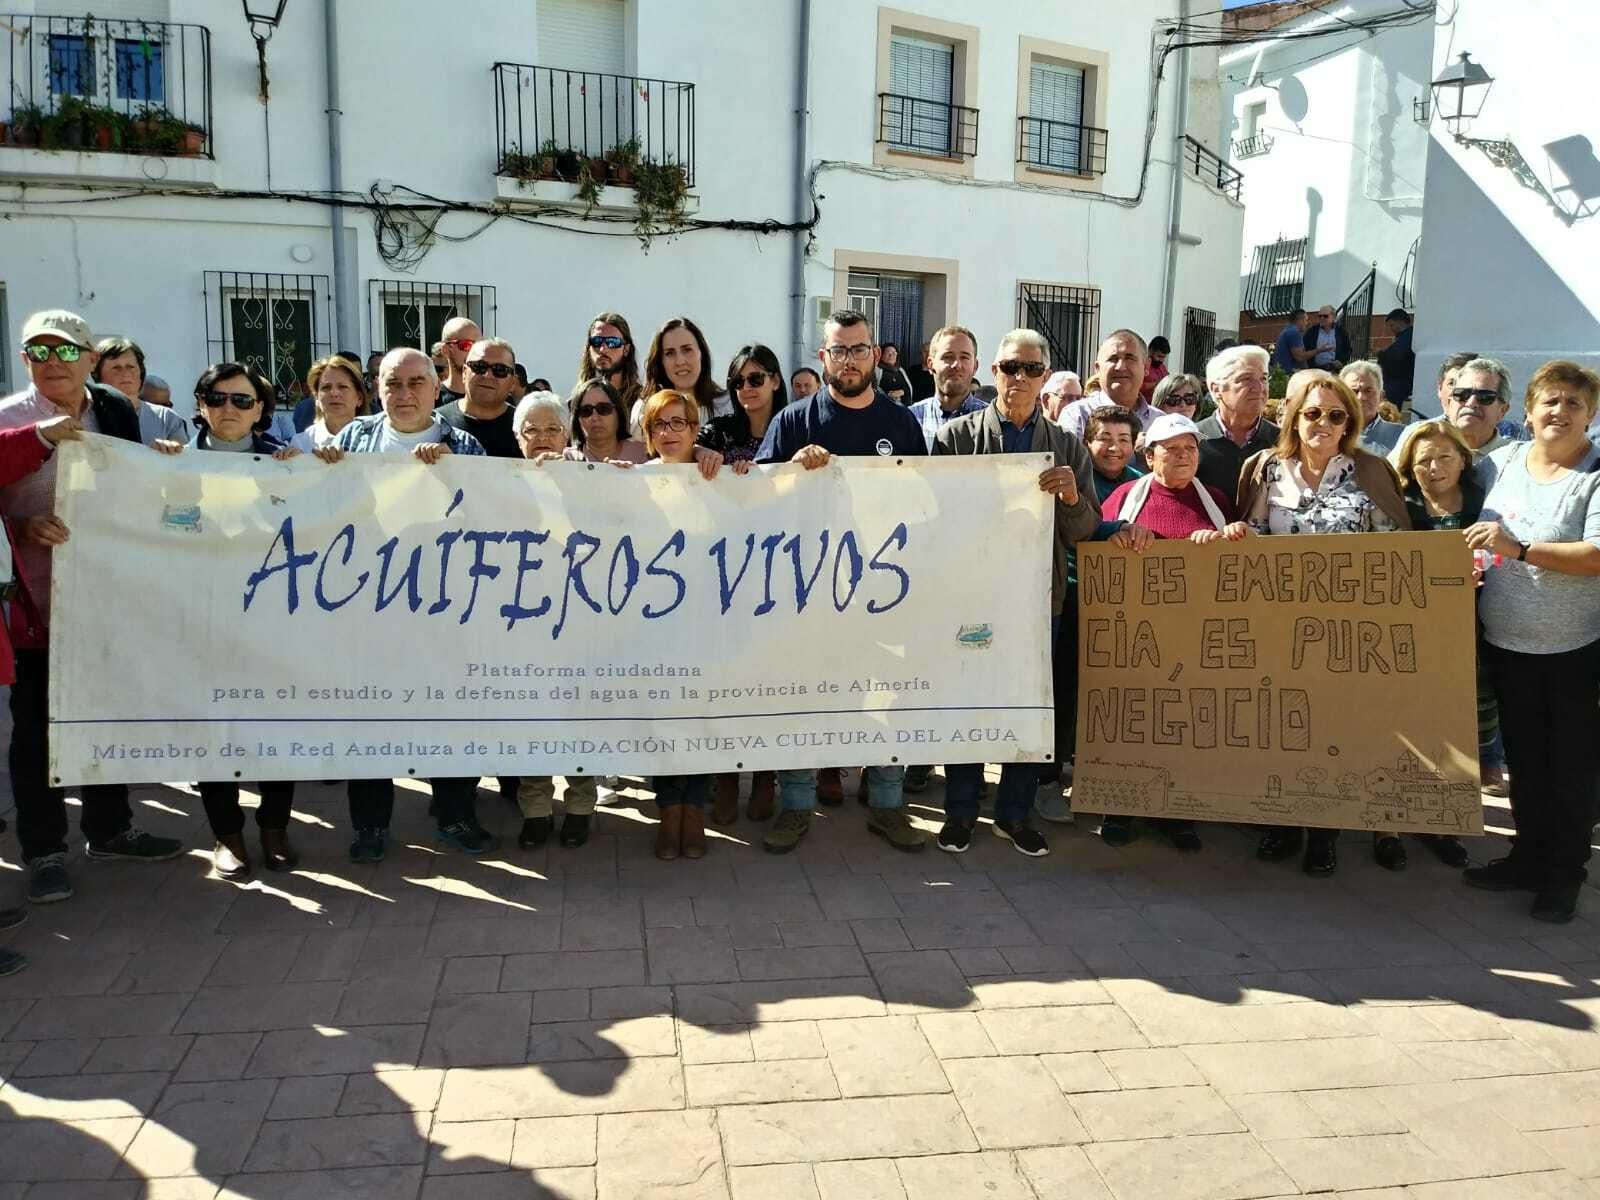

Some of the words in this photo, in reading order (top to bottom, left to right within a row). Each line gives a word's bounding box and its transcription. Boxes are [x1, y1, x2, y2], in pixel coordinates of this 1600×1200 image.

[243, 487, 687, 641] ACUÍFEROS
[709, 521, 910, 617] VIVOS
[1083, 553, 1126, 605] NO
[1141, 556, 1187, 605] ES
[1201, 618, 1256, 669] ES
[1292, 616, 1418, 674] PURO
[212, 686, 265, 703] para
[276, 685, 297, 699] el
[308, 685, 393, 700] estudio
[402, 688, 415, 703] y
[426, 685, 445, 700] la
[456, 685, 539, 700] defensa
[550, 685, 580, 700] del
[590, 687, 639, 703] agua
[648, 688, 671, 700] en
[680, 685, 700, 700] la
[708, 682, 808, 702] provincia
[817, 680, 839, 694] de
[849, 676, 931, 692] Almería
[466, 663, 586, 677] Plataforma
[595, 663, 702, 677] ciudadana
[92, 743, 208, 759] Miembro
[220, 742, 246, 757] de
[258, 742, 278, 757] la
[289, 742, 335, 757] Red
[345, 741, 453, 756] Andaluza
[464, 741, 488, 755] de
[499, 741, 517, 755] la
[528, 736, 676, 755] FUNDACIÓN
[685, 735, 768, 751] NUEVA
[776, 729, 887, 747] CULTURA
[895, 729, 943, 743] DEL
[951, 727, 1018, 743] AGUA
